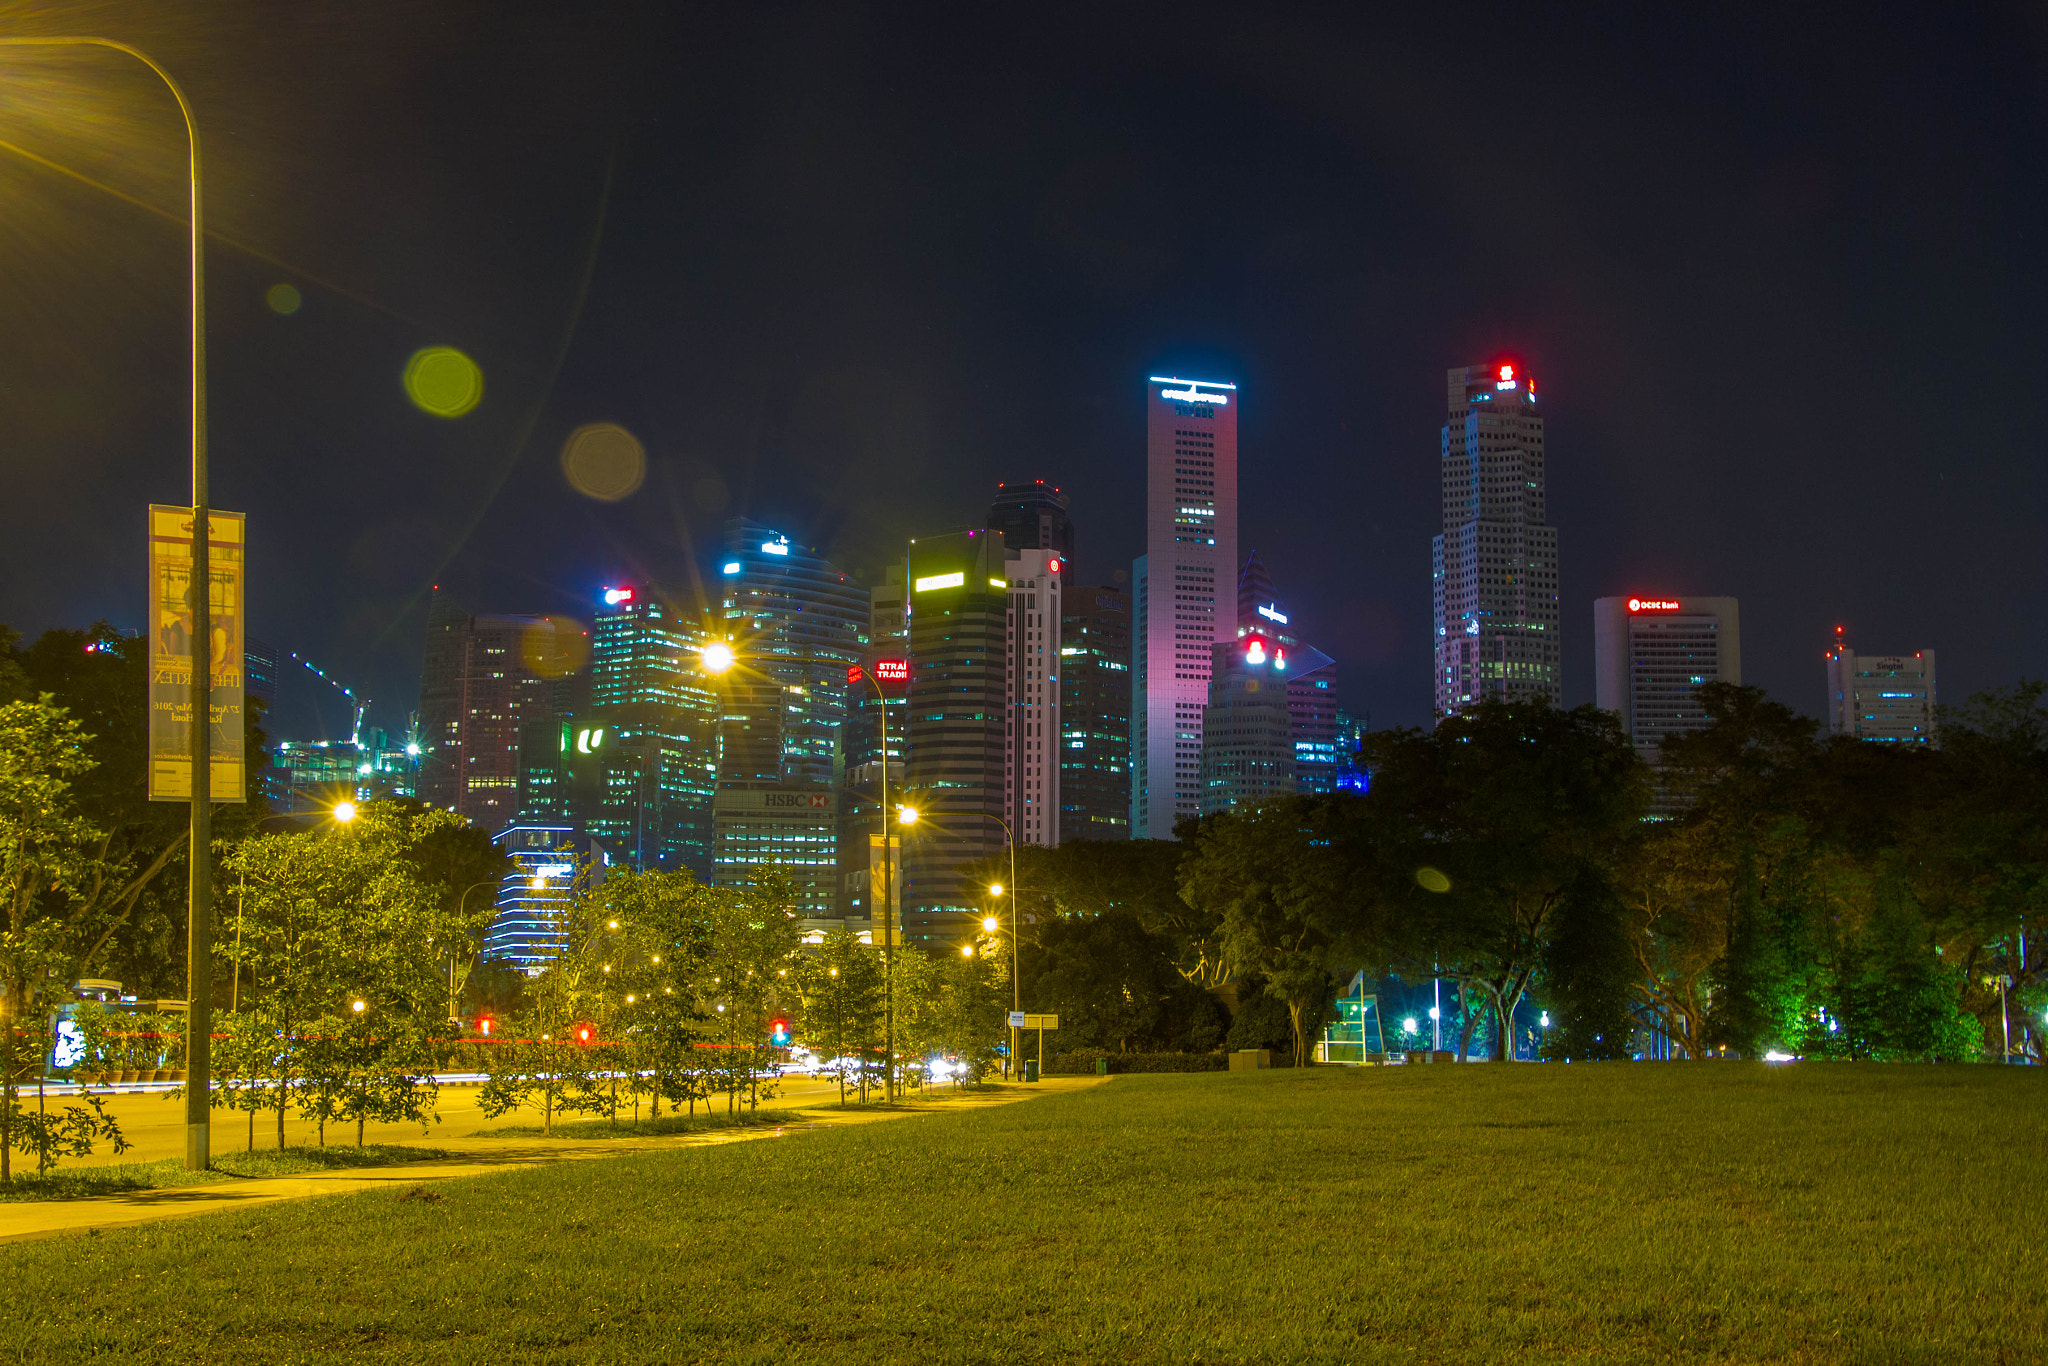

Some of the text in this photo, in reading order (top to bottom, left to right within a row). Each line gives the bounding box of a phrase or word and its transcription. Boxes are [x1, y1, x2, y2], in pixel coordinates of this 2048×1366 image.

[1641, 601, 1679, 609] OCBC Bank
[879, 662, 907, 670] STRAI
[765, 794, 806, 807] HSBC
